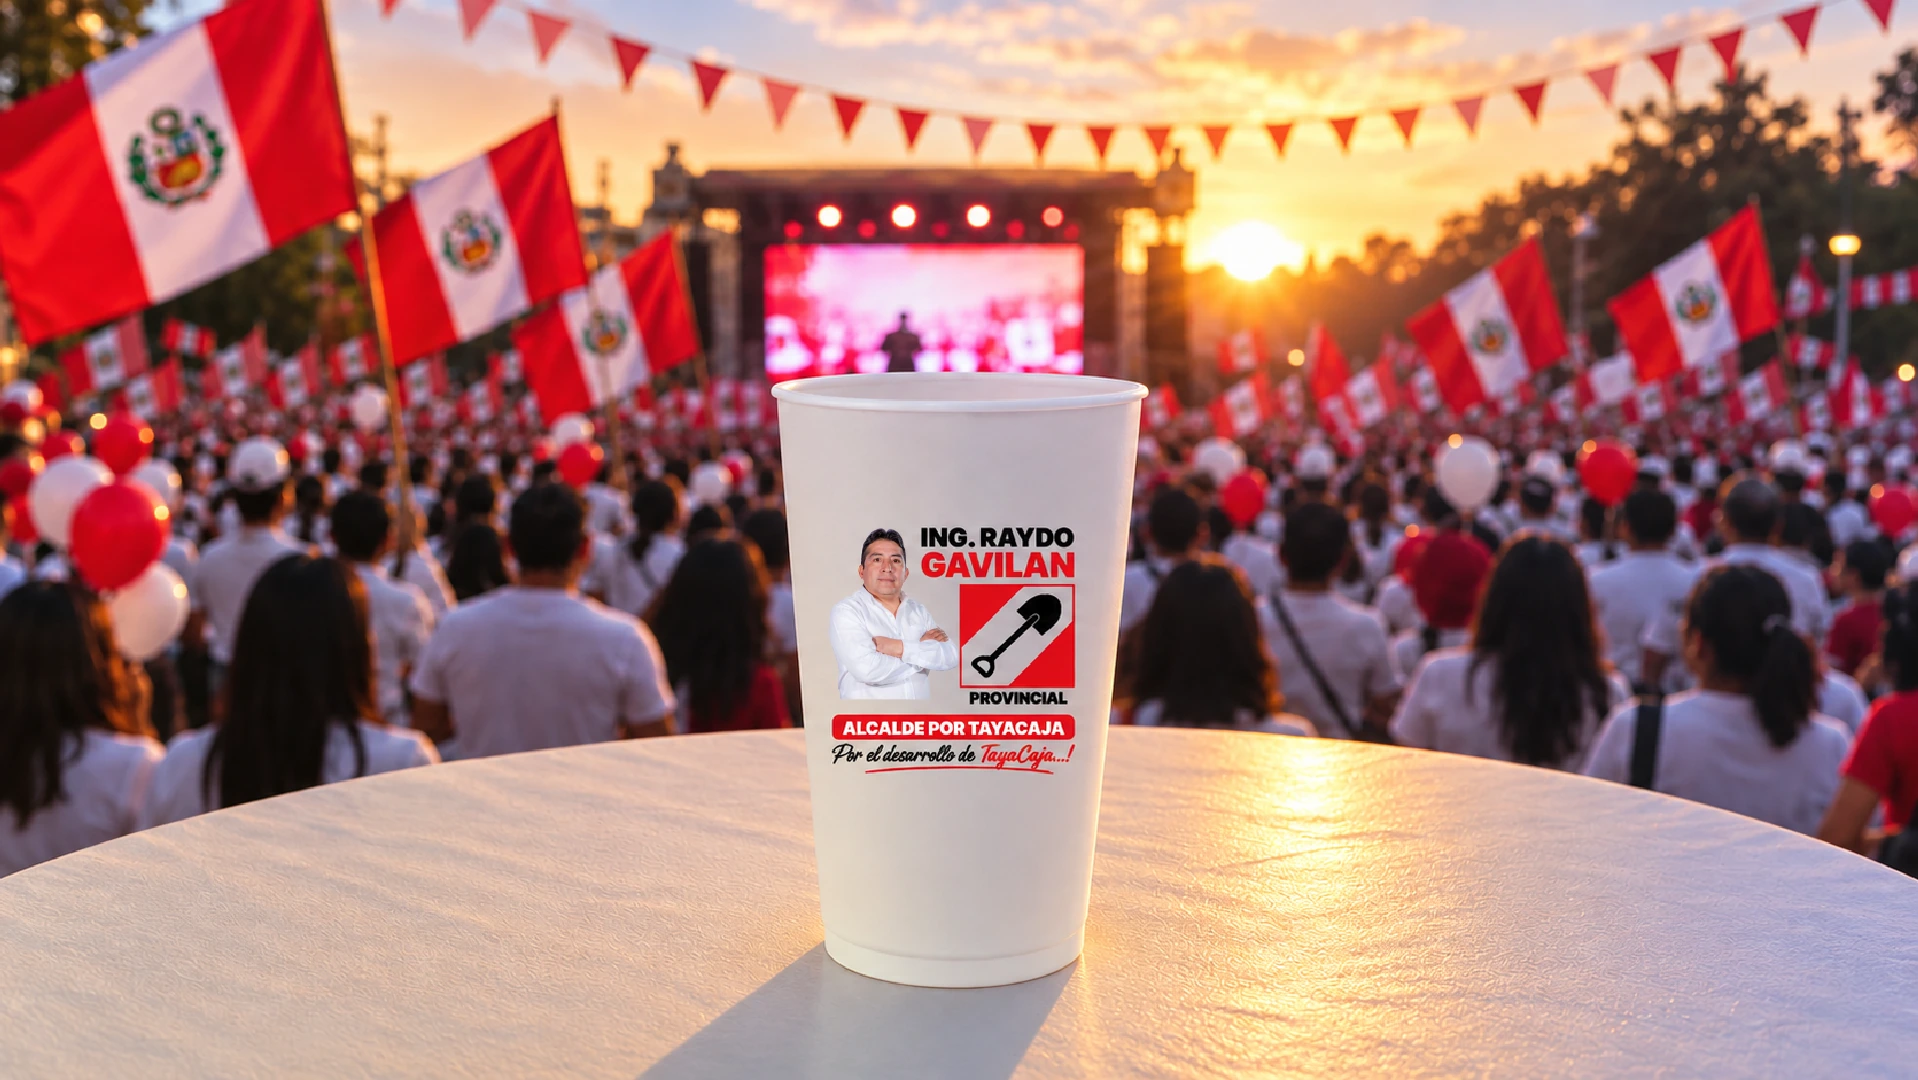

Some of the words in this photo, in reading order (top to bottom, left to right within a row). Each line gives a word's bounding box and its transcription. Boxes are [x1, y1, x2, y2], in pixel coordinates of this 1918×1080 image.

[921, 527, 976, 547] ING.
[980, 527, 1075, 547] RAYDO
[921, 551, 1075, 578] GAVILAN
[969, 692, 1068, 705] PROVINCIAL
[842, 721, 925, 736] ALCALDE
[928, 721, 966, 736] POR
[968, 721, 1065, 736] TAYACAJA
[831, 743, 863, 764] Por
[866, 744, 884, 762] el
[882, 744, 956, 762] desarrollo
[958, 744, 976, 762] de
